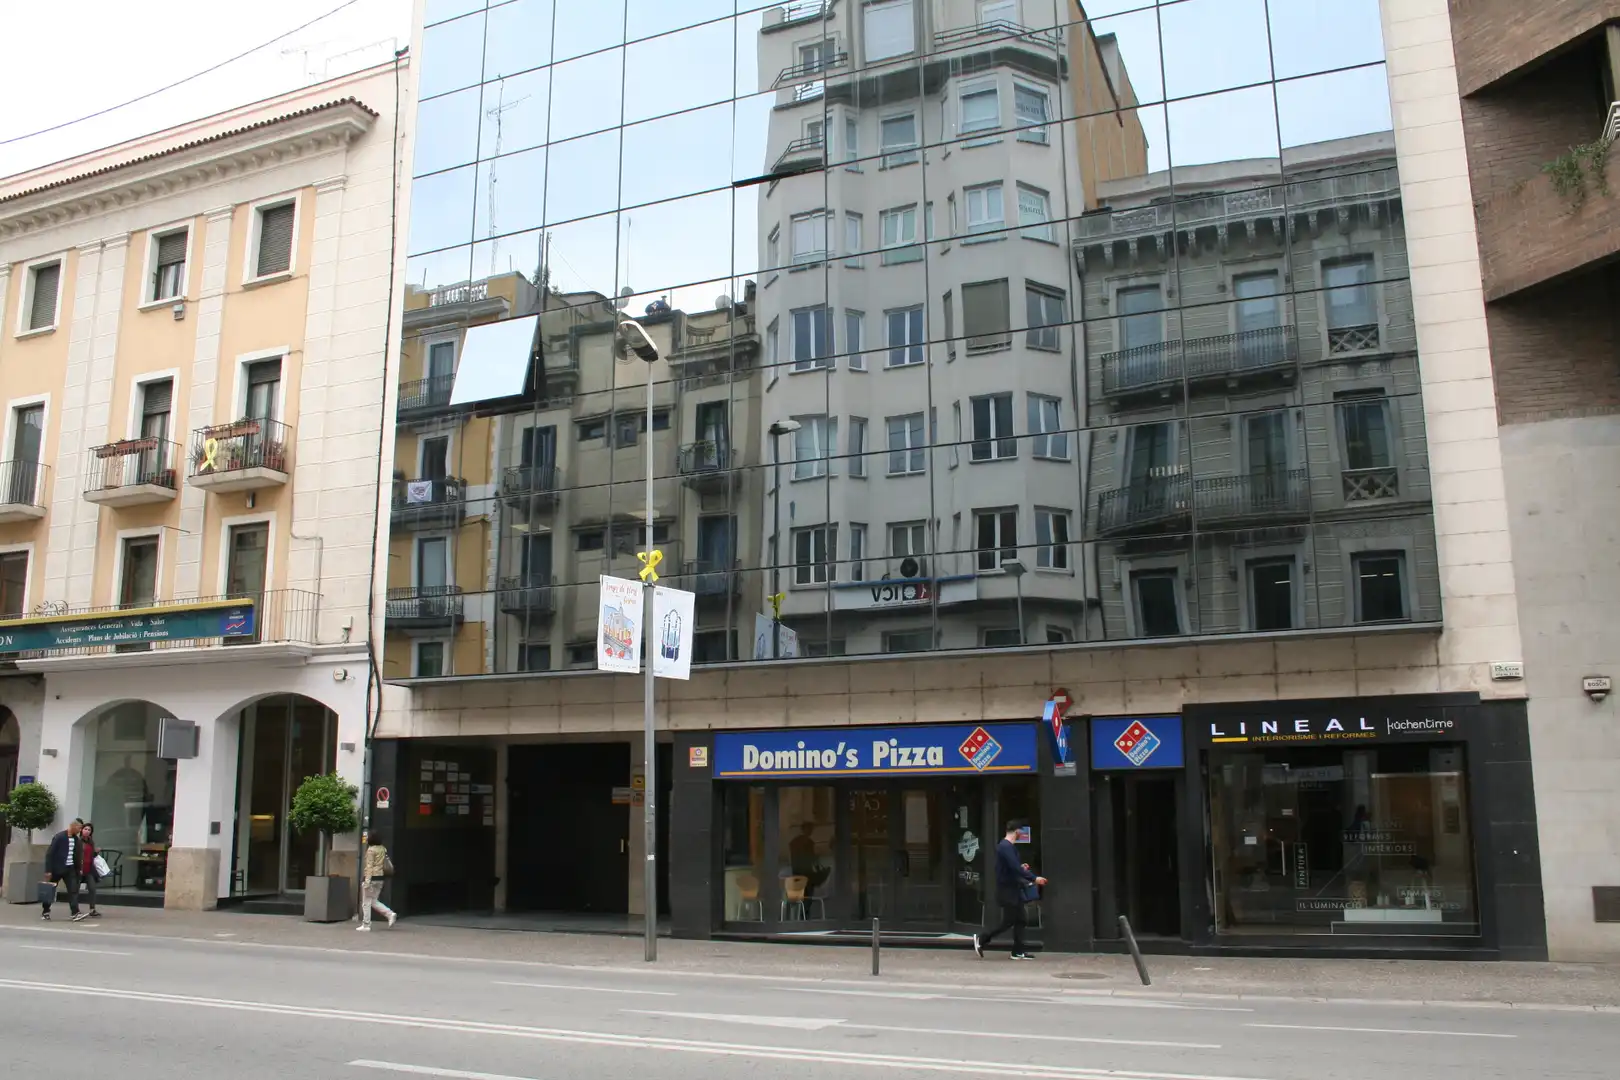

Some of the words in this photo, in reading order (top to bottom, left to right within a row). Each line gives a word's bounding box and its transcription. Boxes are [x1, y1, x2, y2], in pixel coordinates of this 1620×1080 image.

[98, 621, 123, 630] Generals
[55, 636, 82, 645] Accidents
[88, 633, 103, 642] Plans
[104, 633, 112, 641] de
[143, 629, 169, 638] Pensions
[1211, 717, 1375, 736] LINEAL
[1252, 733, 1317, 742] INTERIORISME
[1323, 731, 1377, 740] REFORMES
[743, 741, 858, 770] Domino's
[872, 738, 944, 767] Pizza
[1134, 748, 1149, 763] Pizza
